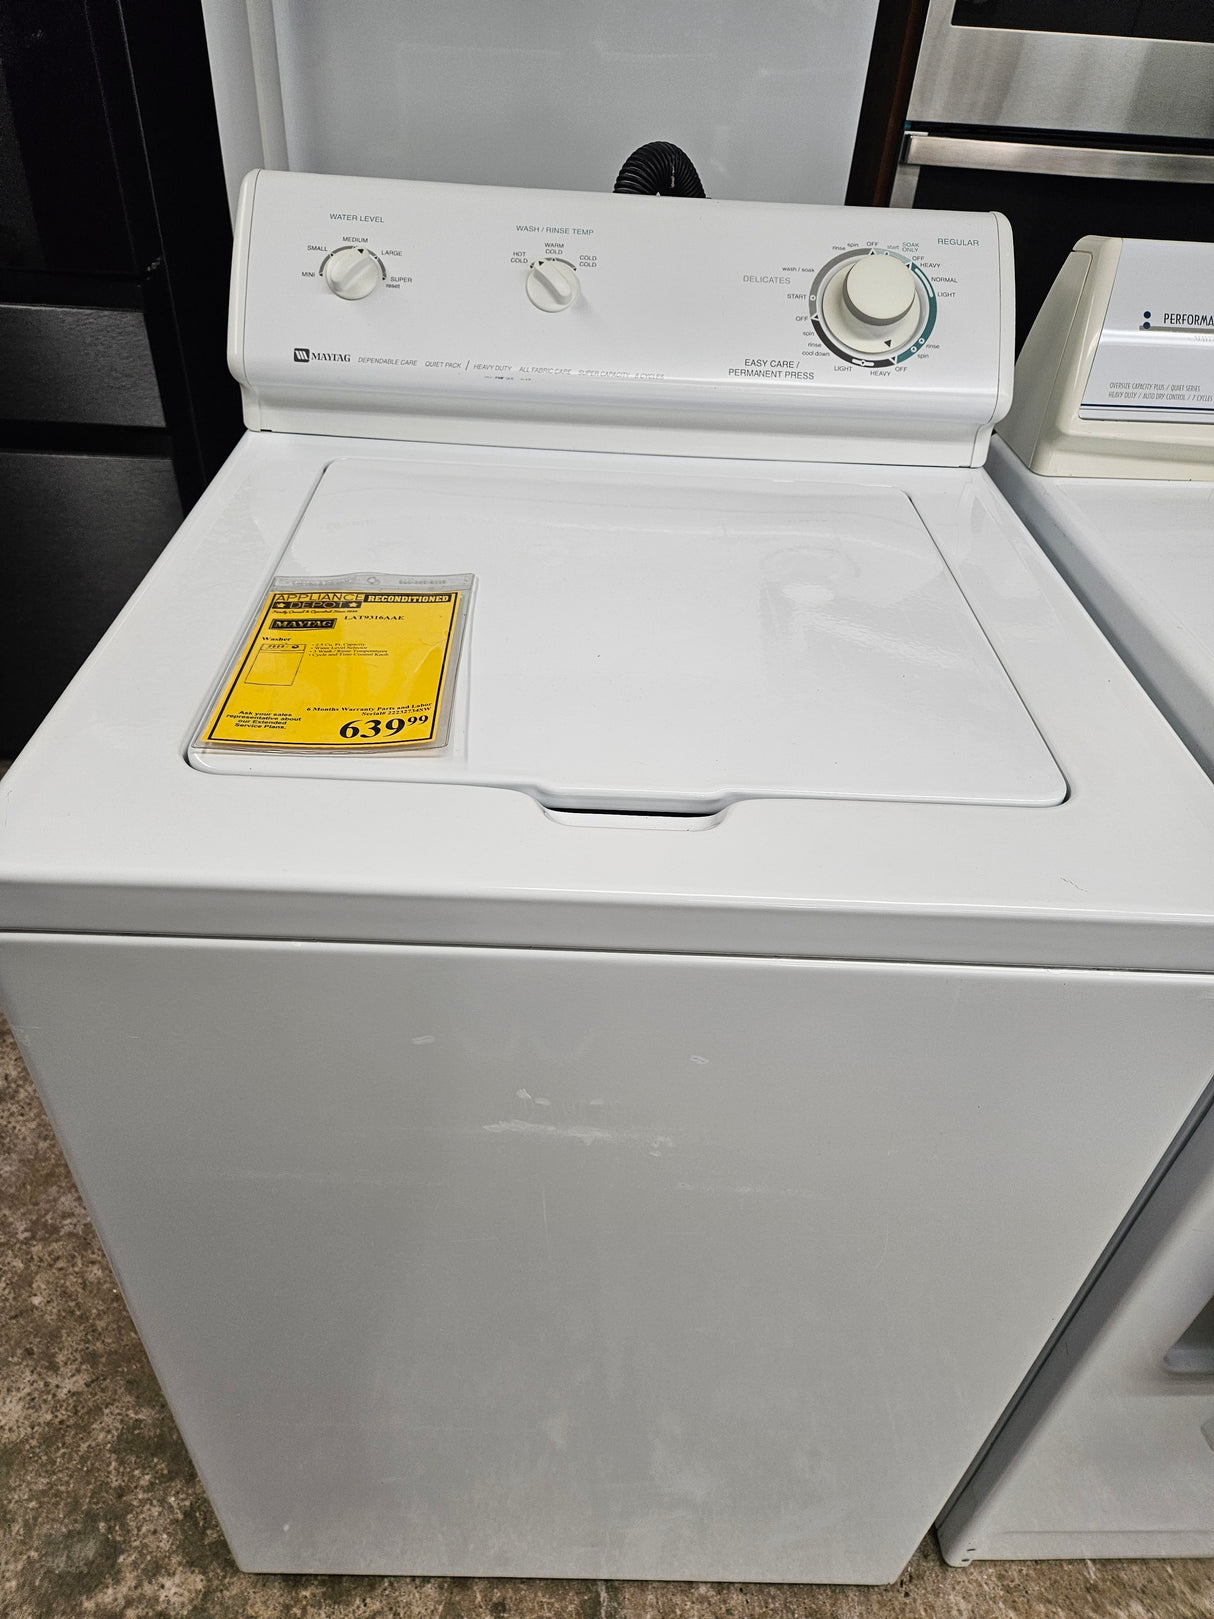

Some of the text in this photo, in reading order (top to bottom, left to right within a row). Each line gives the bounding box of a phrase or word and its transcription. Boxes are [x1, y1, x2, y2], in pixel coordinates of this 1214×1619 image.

[330, 213, 384, 223] WATER LEVEL
[546, 226, 570, 234] RINSE
[572, 228, 594, 236] TEMP
[938, 238, 980, 246] REGULAR
[743, 275, 791, 284] DELICATES
[1164, 312, 1214, 326] PERFORMA
[311, 352, 350, 362] MAYTAG
[358, 356, 398, 366] DEPENDABLE
[744, 359, 768, 367] EASY
[770, 360, 794, 368] CARE
[728, 368, 814, 380] PERMANENT PRESS
[275, 593, 364, 601] APPLIANCE
[275, 620, 332, 628] MAYTAG
